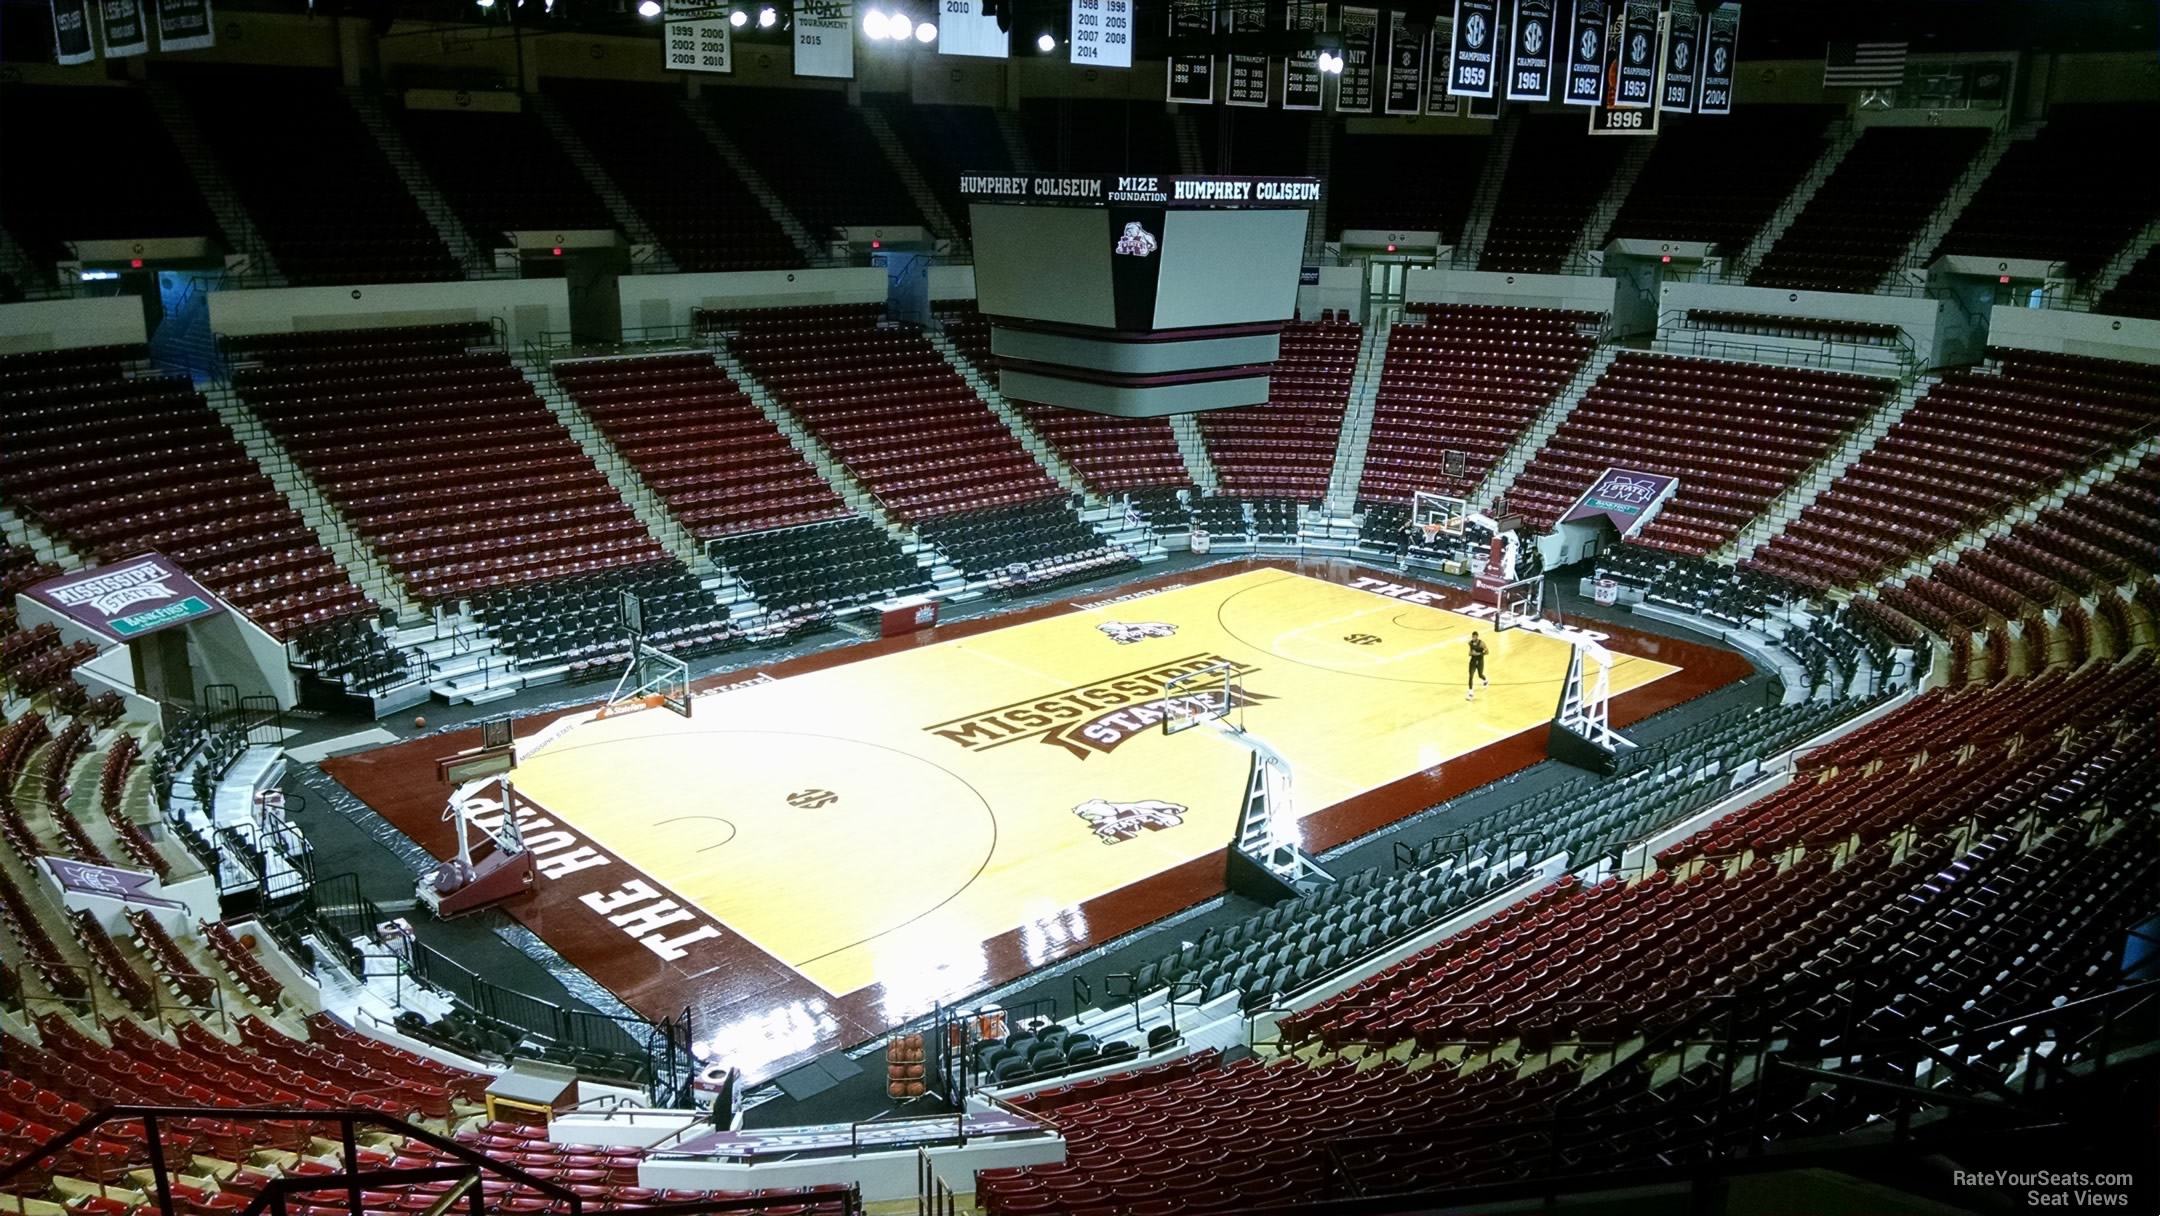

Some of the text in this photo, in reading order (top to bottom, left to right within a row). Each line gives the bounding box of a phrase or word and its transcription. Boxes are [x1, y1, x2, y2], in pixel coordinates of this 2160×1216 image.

[804, 0, 842, 17] NCAA
[947, 0, 969, 14] 2010
[1106, 0, 1126, 13] 1998
[799, 18, 848, 29] TOURNAMENT
[1078, 13, 1126, 29] 2001 2005
[672, 26, 724, 39] 1999 2000
[1077, 29, 1126, 44] 2007 2008
[1466, 14, 1485, 47] SEC
[1525, 21, 1542, 53] SEC
[672, 40, 725, 53] 2002 2003
[800, 35, 822, 45] 2015
[1581, 29, 1598, 59] SEC
[1077, 45, 1098, 58] 2014
[1459, 51, 1491, 62] CHAMPIONS
[1631, 34, 1648, 63] SEC
[1675, 42, 1689, 70] SEC
[672, 53, 724, 66] 2009 2010
[1349, 49, 1367, 65] NIT
[1517, 57, 1547, 68] CHAMPIONS
[1459, 66, 1486, 86] 1959
[1574, 63, 1600, 73] CHAMPIONS
[1623, 66, 1651, 77] CHAMPIONS
[1517, 72, 1540, 90] 1961
[1574, 77, 1597, 95] 1962
[1624, 80, 1647, 97] 1963
[1667, 86, 1686, 102] 1991
[1705, 89, 1727, 105] 2004
[1606, 111, 1642, 128] 1996
[960, 176, 1101, 197] HUMPHREY COLISEUM
[1118, 177, 1158, 191] MIZE
[1174, 181, 1320, 200] HUMPHREY COLISEUM
[1108, 192, 1167, 202] FOUNDATION
[1611, 484, 1645, 496] STATE
[51, 563, 168, 604] MISSISSIPPI
[1349, 576, 1447, 604] THE
[103, 587, 160, 609] STATE
[932, 655, 1251, 748] MISSISSIPPI
[578, 879, 722, 962] THE
